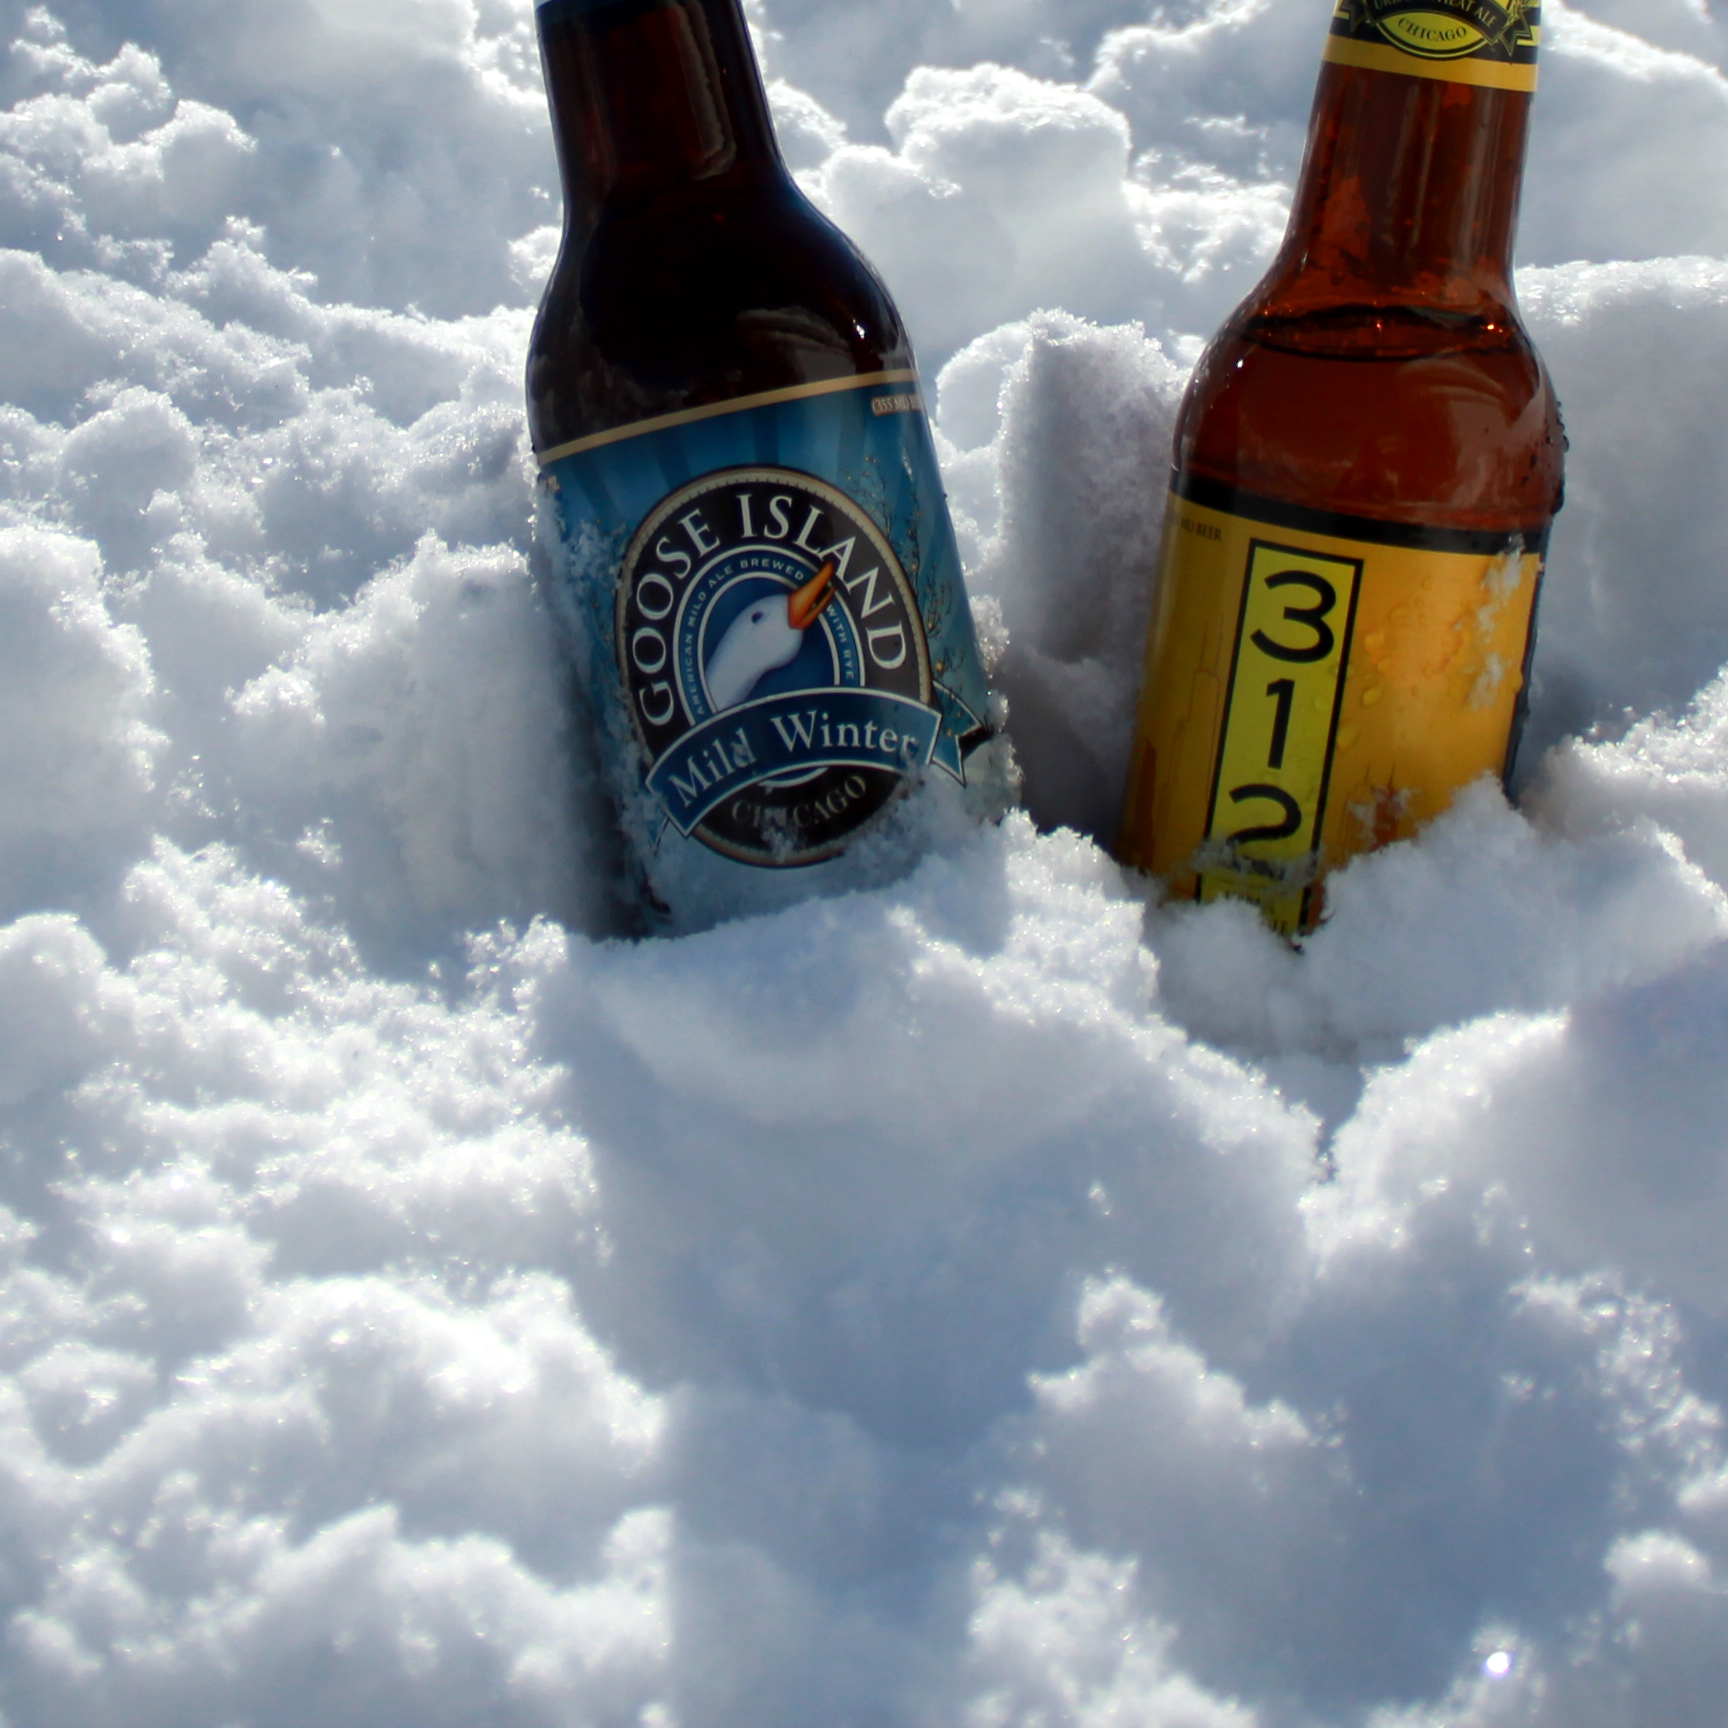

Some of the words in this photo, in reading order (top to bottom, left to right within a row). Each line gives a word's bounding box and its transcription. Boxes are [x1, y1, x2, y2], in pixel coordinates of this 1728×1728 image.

[1397, 17, 1468, 43] CHICAGO
[1474, 2, 1499, 28] ALE
[708, 565, 734, 588] ALE
[739, 558, 805, 581] BREWED
[632, 508, 720, 727] GOOSE
[736, 493, 908, 670] ISLAND
[688, 591, 707, 628] MILD
[826, 604, 848, 643] WITH
[684, 633, 705, 716] AMERICAN
[843, 650, 854, 680] RYE
[668, 727, 758, 809] Mild
[770, 709, 920, 758] Winter
[731, 775, 867, 828] CCAGO
